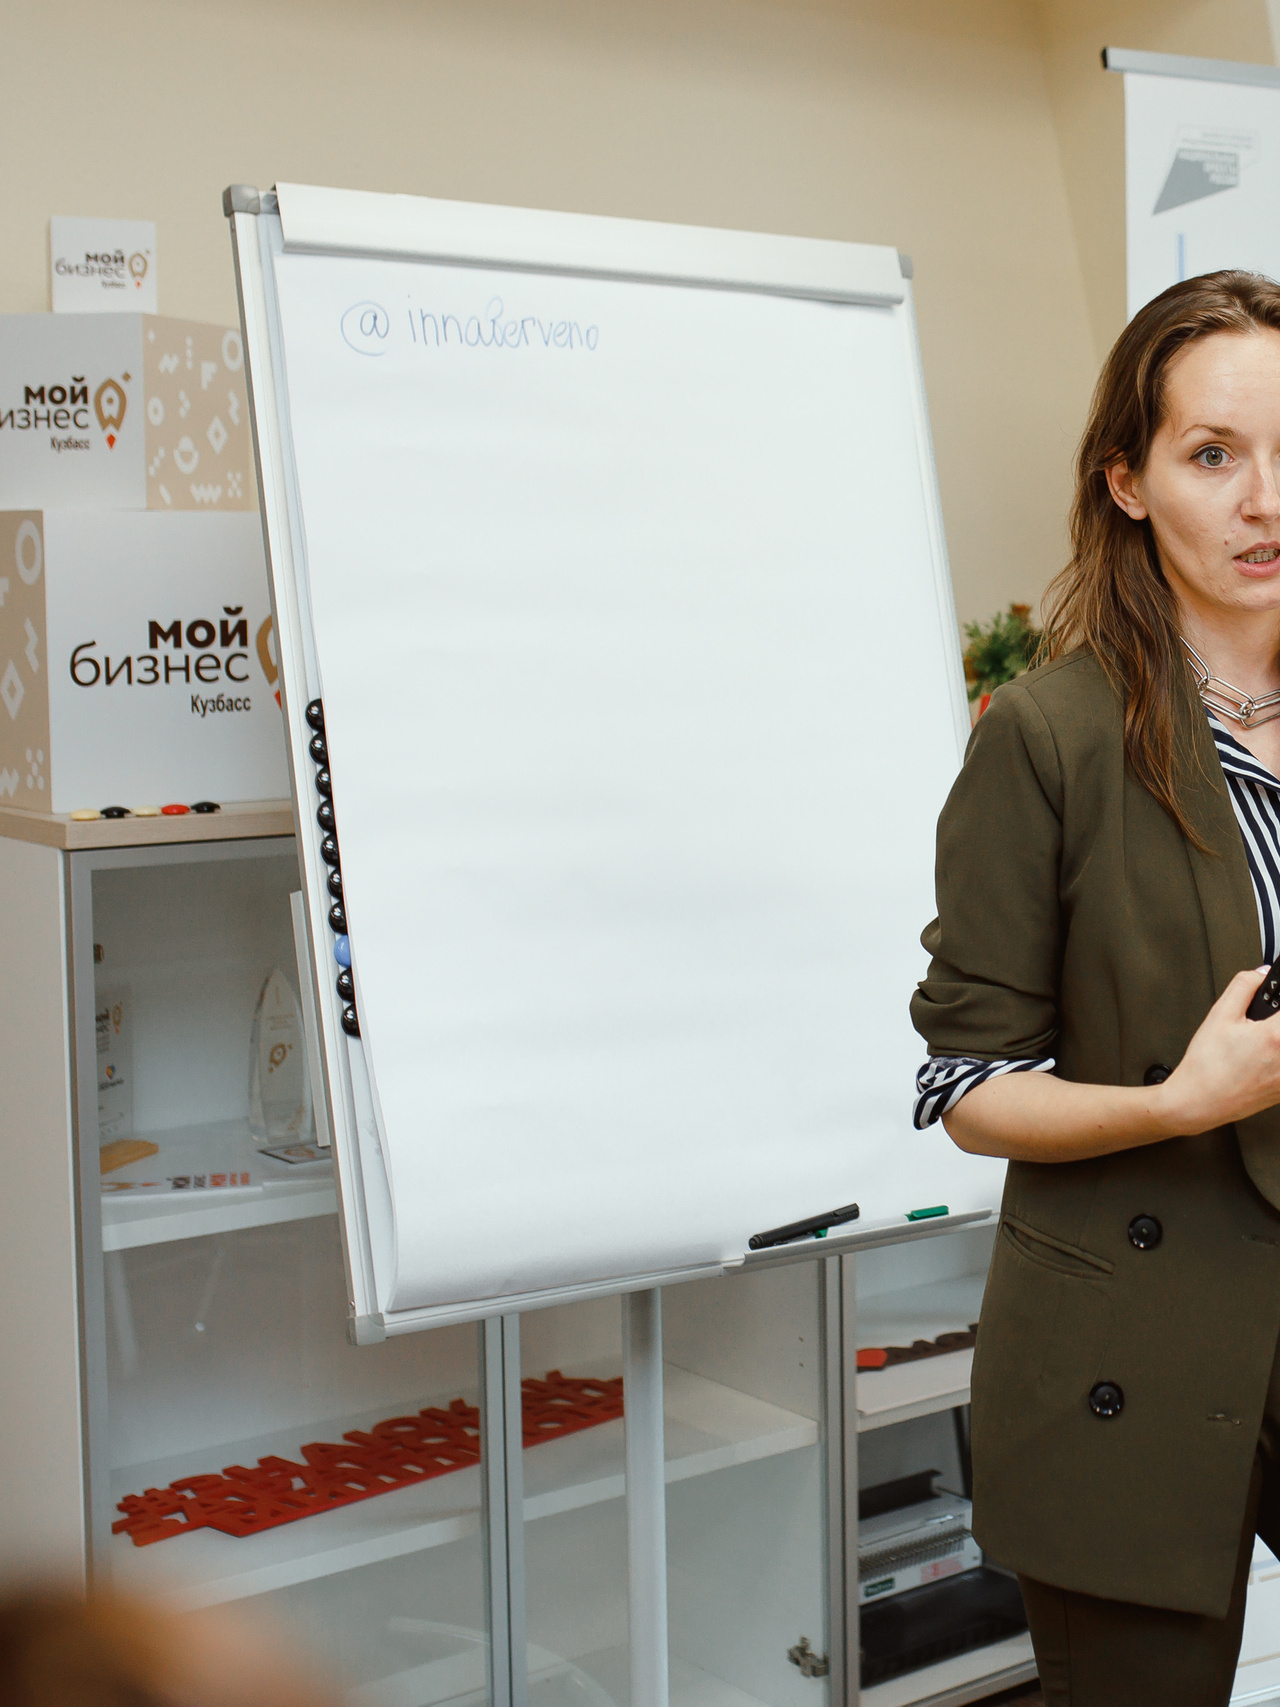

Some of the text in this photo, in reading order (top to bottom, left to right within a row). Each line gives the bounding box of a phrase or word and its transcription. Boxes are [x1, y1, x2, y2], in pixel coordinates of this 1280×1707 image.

[50, 436, 90, 453] Кузбасс
[69, 640, 250, 687] бизнес
[190, 694, 252, 717] Кузбасс
